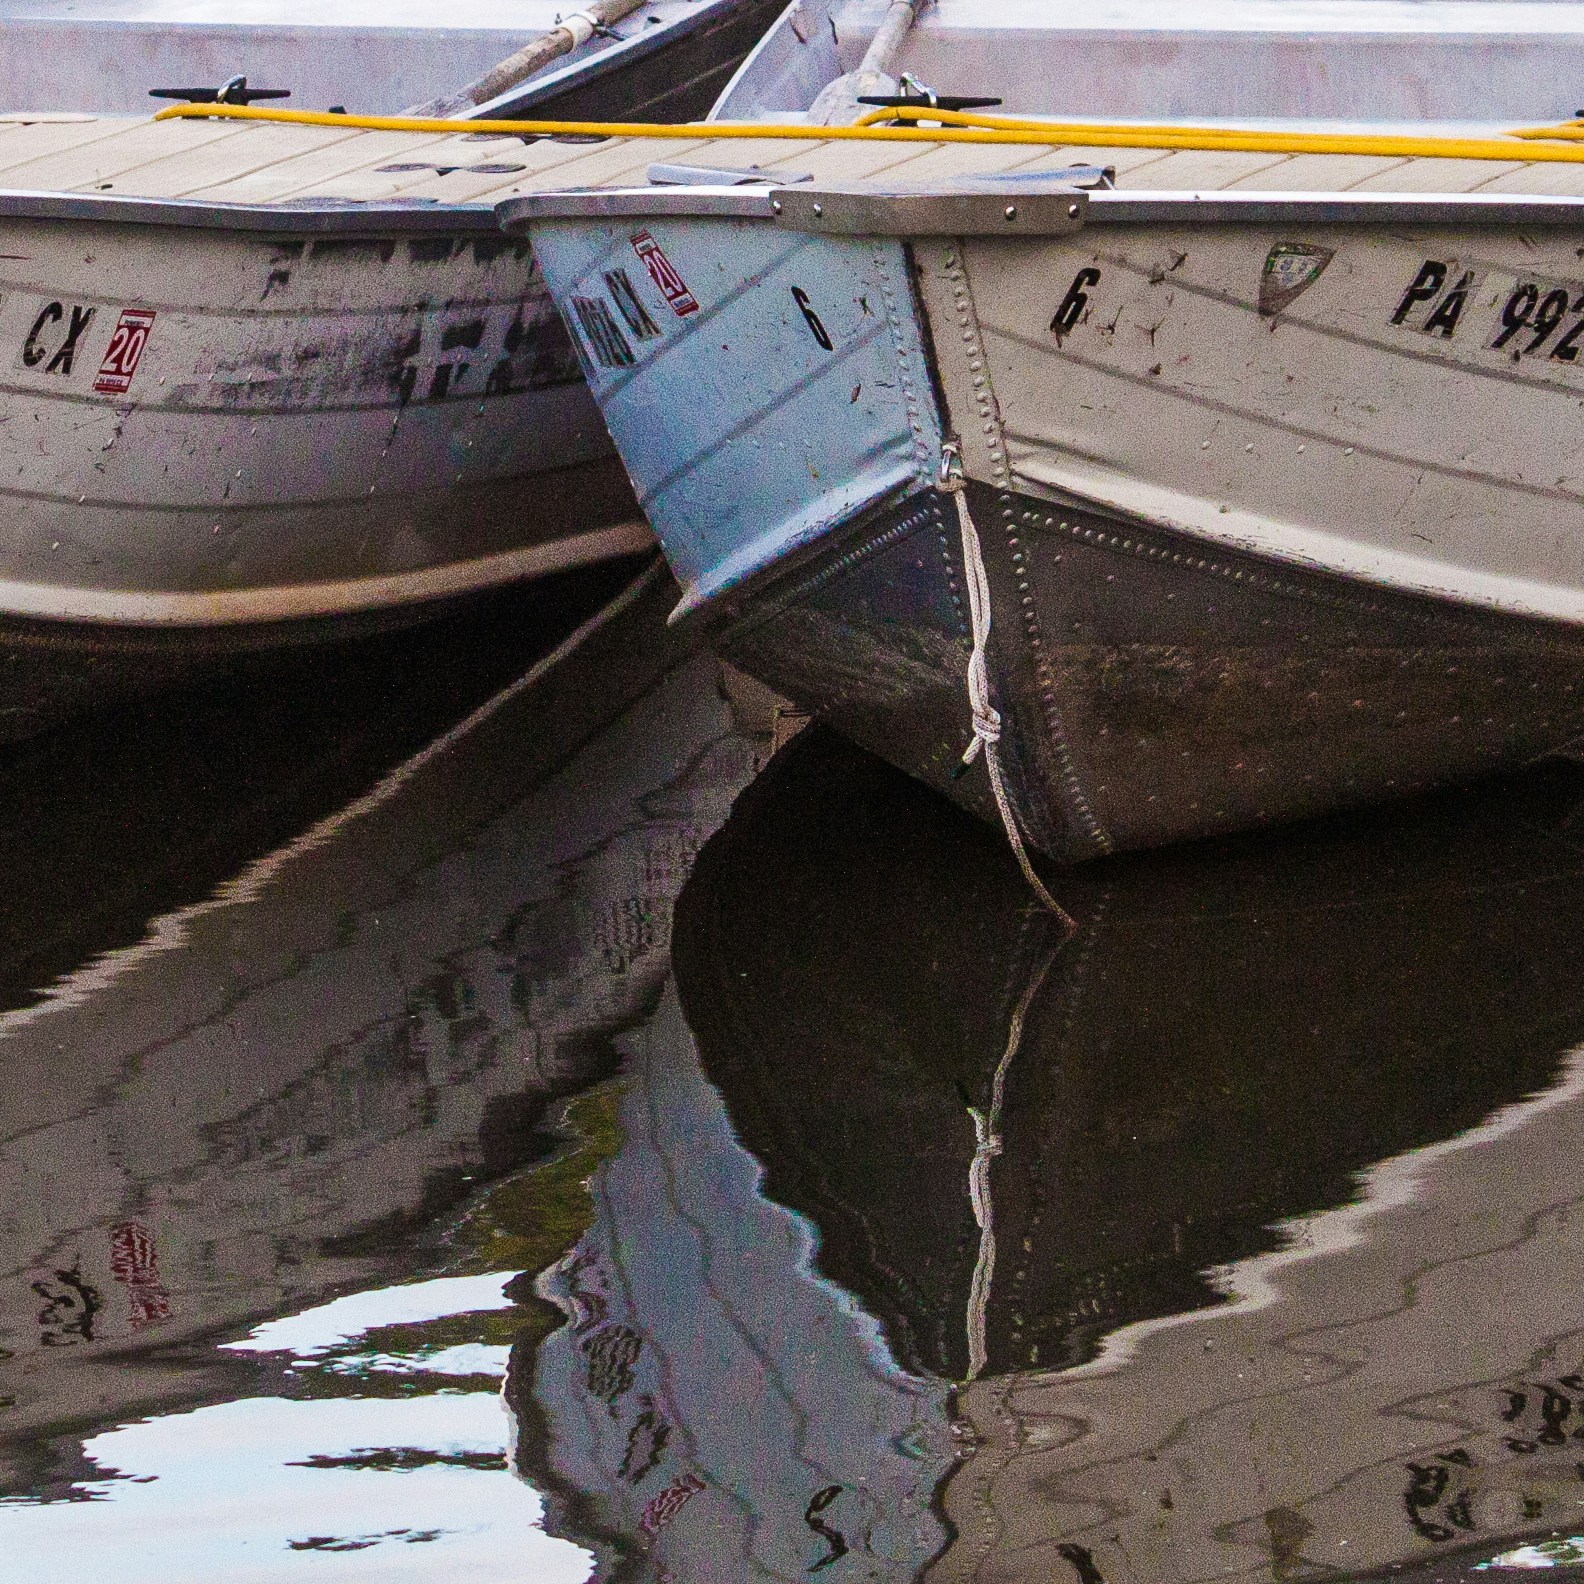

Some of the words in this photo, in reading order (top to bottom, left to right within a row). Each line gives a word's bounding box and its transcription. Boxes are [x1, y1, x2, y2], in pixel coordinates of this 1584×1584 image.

[642, 249, 685, 299] 20
[1049, 267, 1102, 335] 6
[1390, 259, 1474, 339] PA
[22, 301, 96, 375] CX
[100, 327, 146, 373] 20
[791, 285, 834, 352] 6
